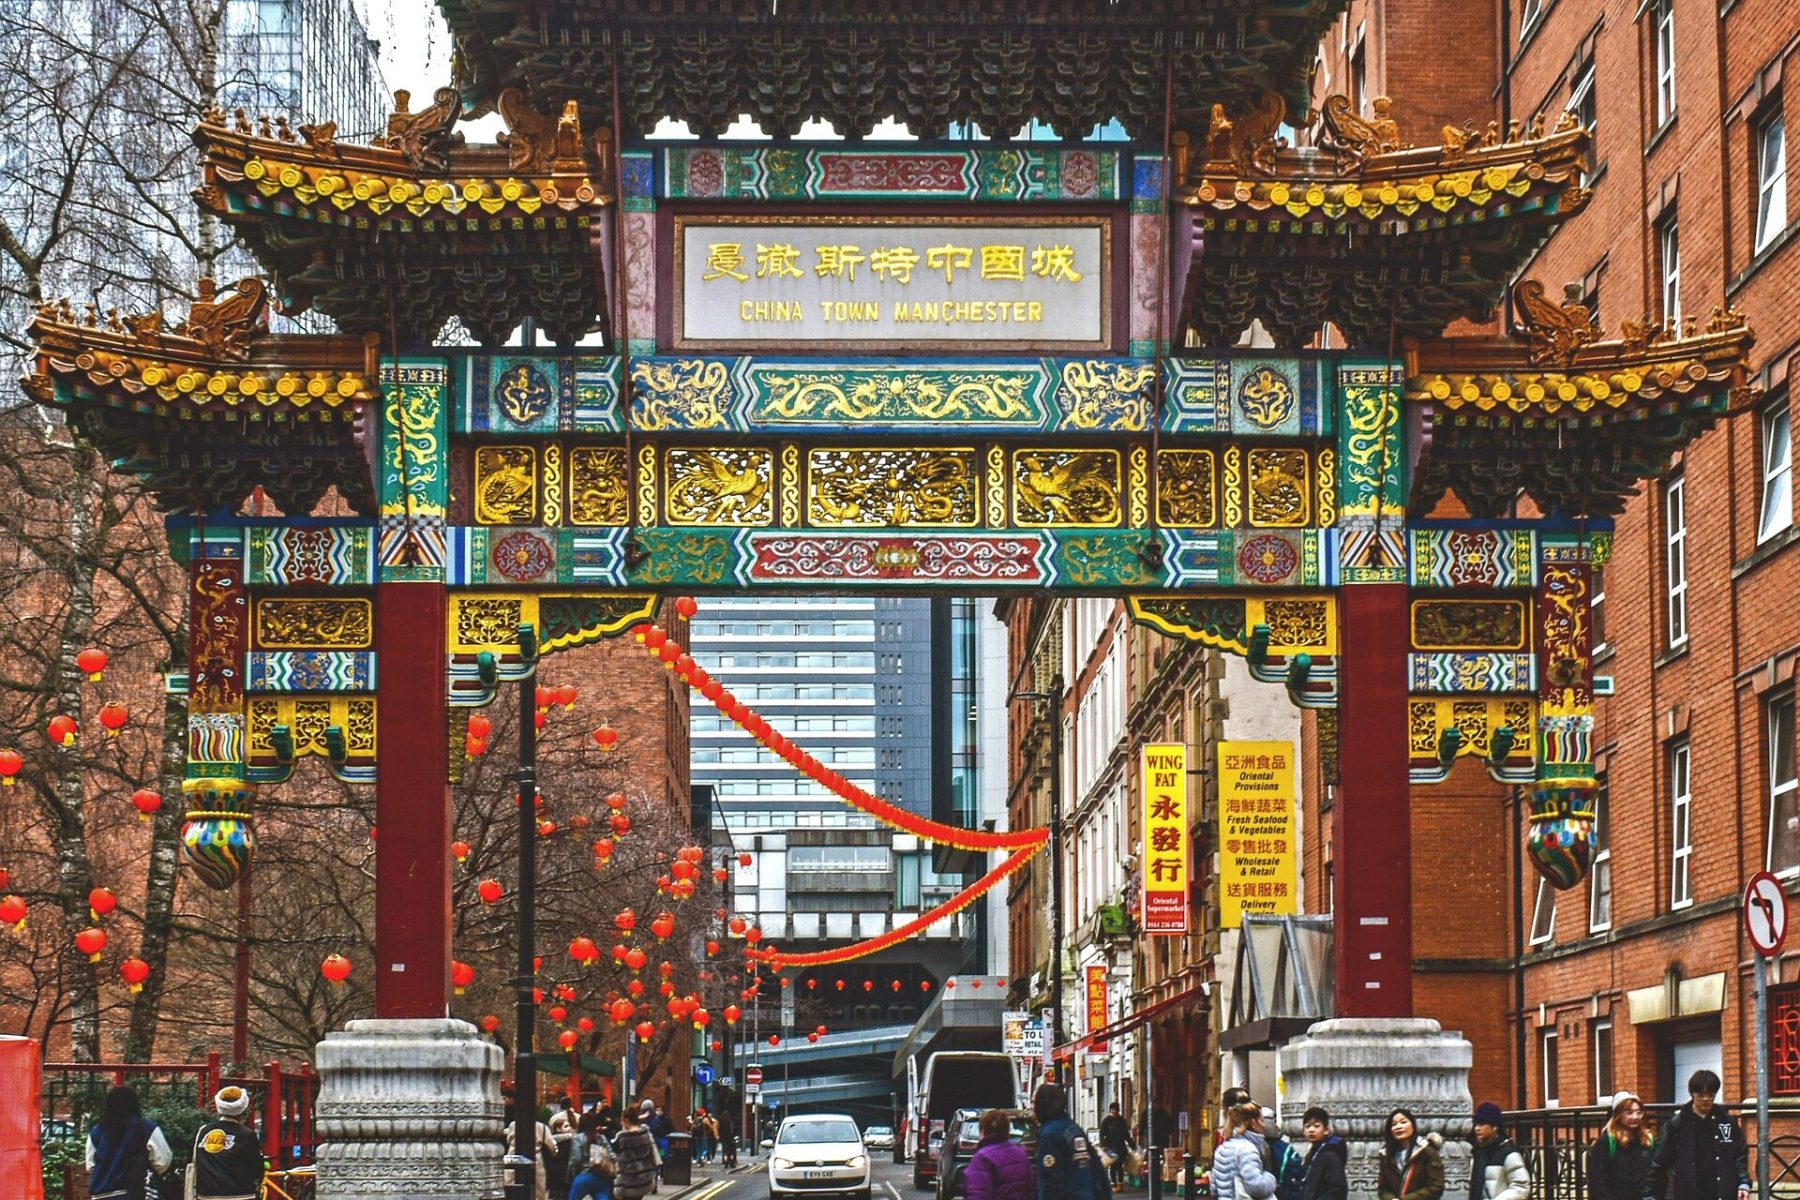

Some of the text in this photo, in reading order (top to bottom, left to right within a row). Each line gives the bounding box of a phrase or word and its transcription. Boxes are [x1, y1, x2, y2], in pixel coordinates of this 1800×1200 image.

[702, 242, 1083, 284] 曼徹斯特中國城
[740, 300, 1044, 324] CHINA TOWN MANCHESTER
[1147, 755, 1183, 769] WING
[1225, 755, 1286, 770] 亞洲食品
[1155, 773, 1177, 787] FAT
[1239, 771, 1274, 781] Oriental
[1234, 782, 1279, 791] Provisions
[1226, 799, 1287, 813] 海鮮蔬菜
[1226, 815, 1288, 824] Fresh Seafood
[1229, 825, 1286, 836] & Vegetables
[1150, 794, 1182, 882] 永發行
[1226, 839, 1287, 854] 零售批發
[1235, 857, 1280, 866] Wholesale
[1240, 867, 1276, 876] & Retail
[1227, 883, 1287, 897] 送貨服務
[1147, 905, 1184, 914] Supermarket
[1240, 900, 1276, 909] Delivery
[1024, 1031, 1036, 1039] TO
